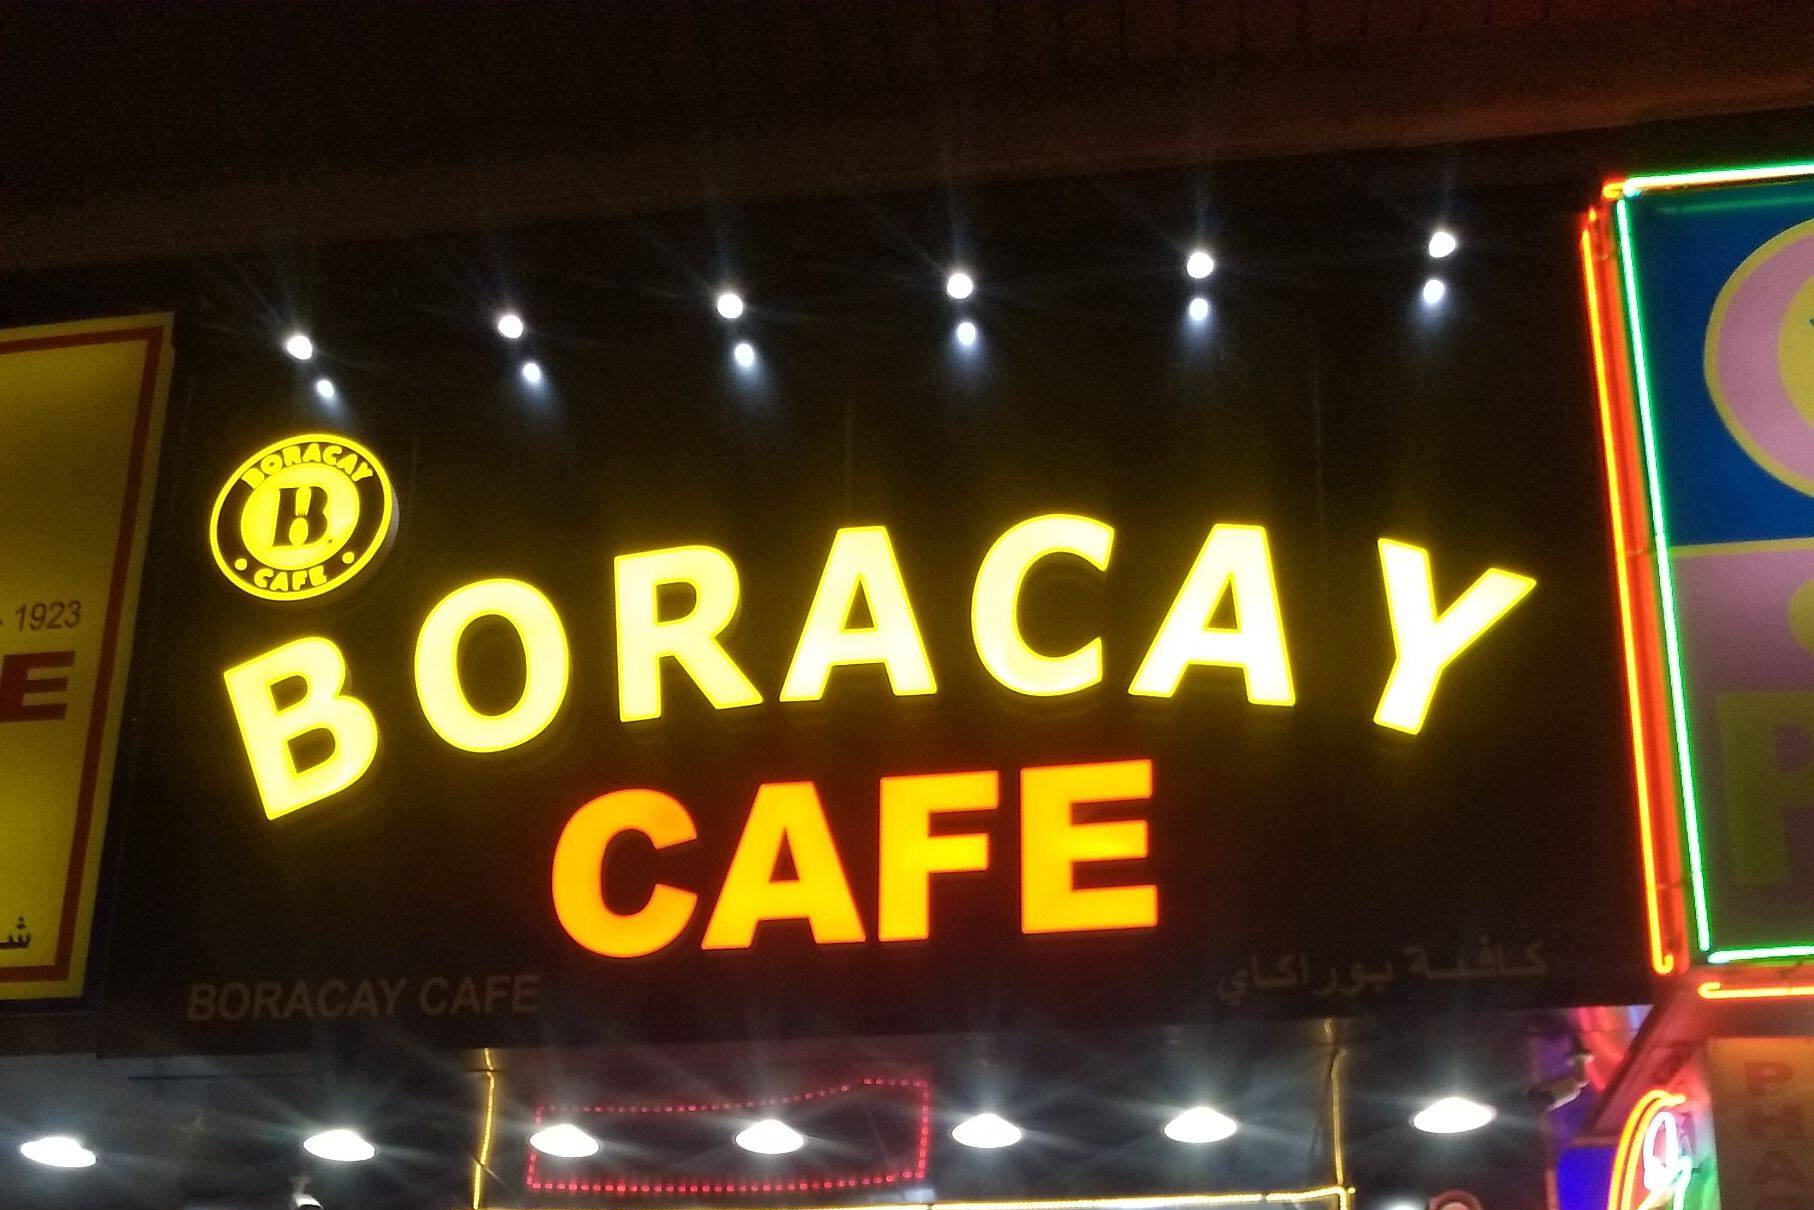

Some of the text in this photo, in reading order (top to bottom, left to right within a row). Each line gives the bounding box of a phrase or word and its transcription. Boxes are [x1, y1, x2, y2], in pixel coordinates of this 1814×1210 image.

[242, 443, 373, 486] BORACAY
[253, 565, 328, 592] CAFE
[15, 600, 82, 632] 1923
[223, 512, 1537, 821] BORACAY
[551, 758, 1158, 958] CAFE
[186, 974, 541, 1022] BORACAY CAFE
